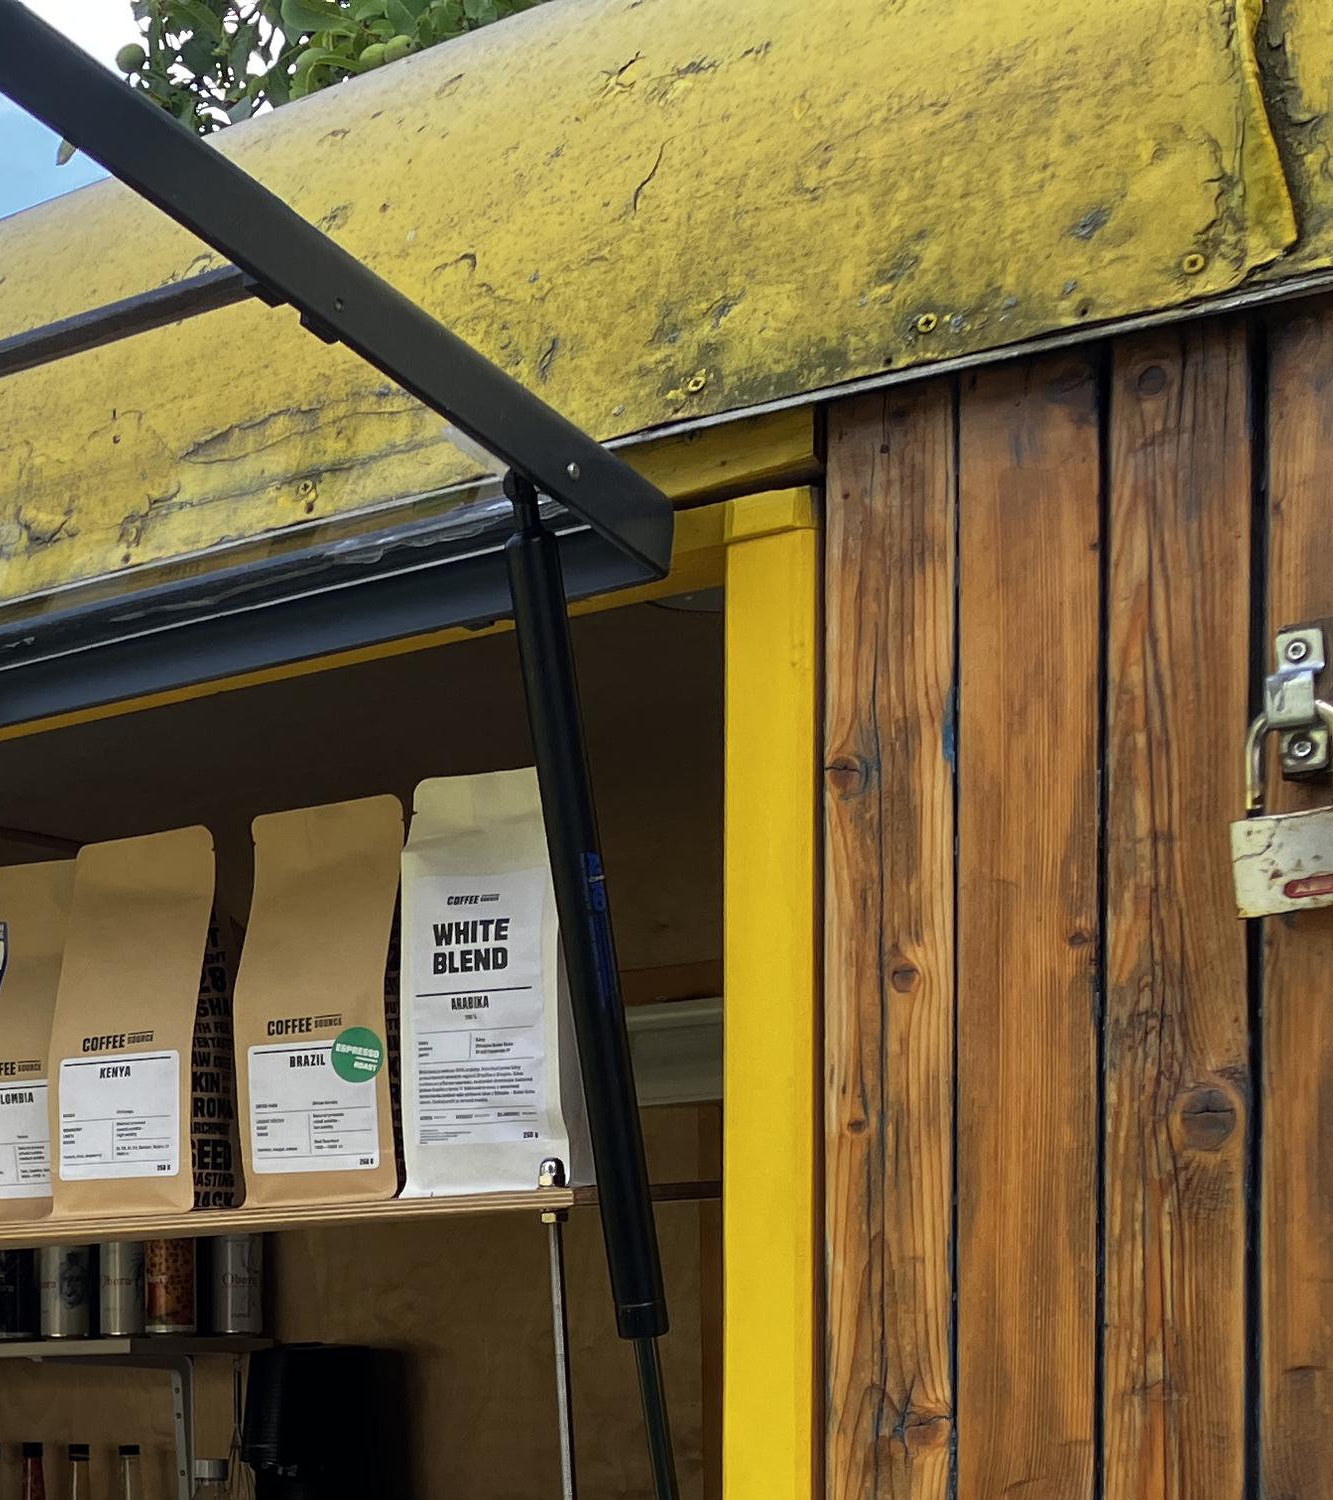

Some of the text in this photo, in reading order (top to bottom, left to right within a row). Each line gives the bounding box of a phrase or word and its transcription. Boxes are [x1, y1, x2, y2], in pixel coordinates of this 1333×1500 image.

[446, 895, 480, 906] COFFEE
[433, 918, 510, 947] WHITE
[433, 947, 508, 975] BLEND
[451, 995, 490, 1010] ARABIKA
[267, 1017, 312, 1036] COFFEE
[82, 1034, 126, 1052] COFFEE
[335, 1043, 380, 1059] ESPRESSO
[289, 1054, 326, 1068] BRAZIL
[353, 1061, 378, 1072] ROAST
[99, 1066, 131, 1079] KENYA
